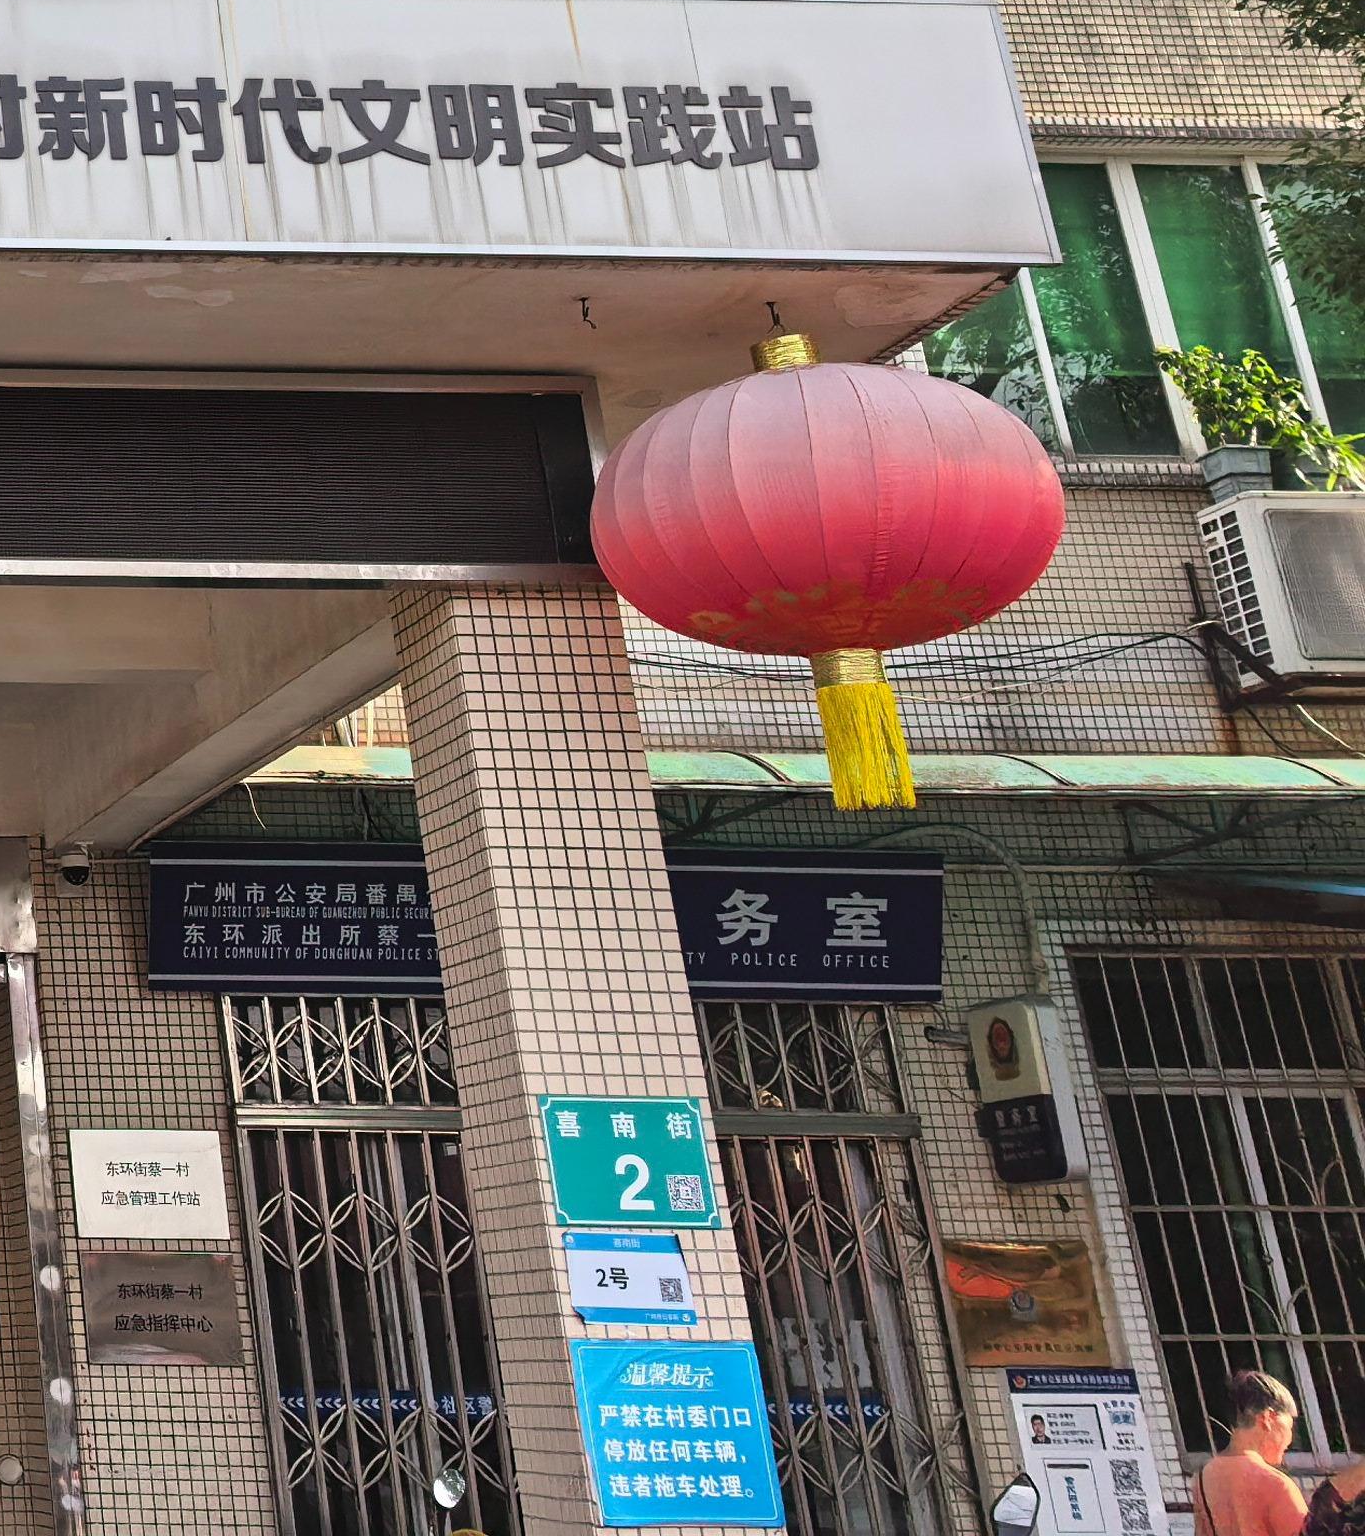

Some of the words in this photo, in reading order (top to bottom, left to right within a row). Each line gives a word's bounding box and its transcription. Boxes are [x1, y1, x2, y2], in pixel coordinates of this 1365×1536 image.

[183, 882, 433, 905] 广州市公安局番禺
[212, 906, 252, 918] DISTRICT
[256, 906, 306, 919] SUB-BUREAU
[309, 906, 319, 919] OF
[322, 906, 368, 919] GUANGZHOU
[370, 906, 401, 919] PUBLIC
[716, 888, 888, 948] 务室
[183, 923, 437, 946] 东环派出所蔡一
[183, 946, 218, 959] CAIYI
[225, 947, 290, 960] COMMUNITY
[295, 947, 309, 960] OF
[315, 947, 373, 961] DONGHUAN
[378, 948, 421, 961] POLICE
[731, 952, 798, 967] POLICE
[823, 954, 891, 969] OFFICE
[554, 1110, 693, 1140] 喜南街
[105, 1161, 190, 1177] 东环街蔡一村
[614, 1153, 656, 1211] 2
[101, 1190, 201, 1207] 应急管理工作站
[595, 1266, 630, 1290] 2号
[117, 1283, 204, 1301] 东环街蔡一村
[114, 1314, 214, 1333] 应急指挥中心
[620, 1362, 715, 1389] 温馨提示
[598, 1403, 752, 1428] 严禁在村委门口
